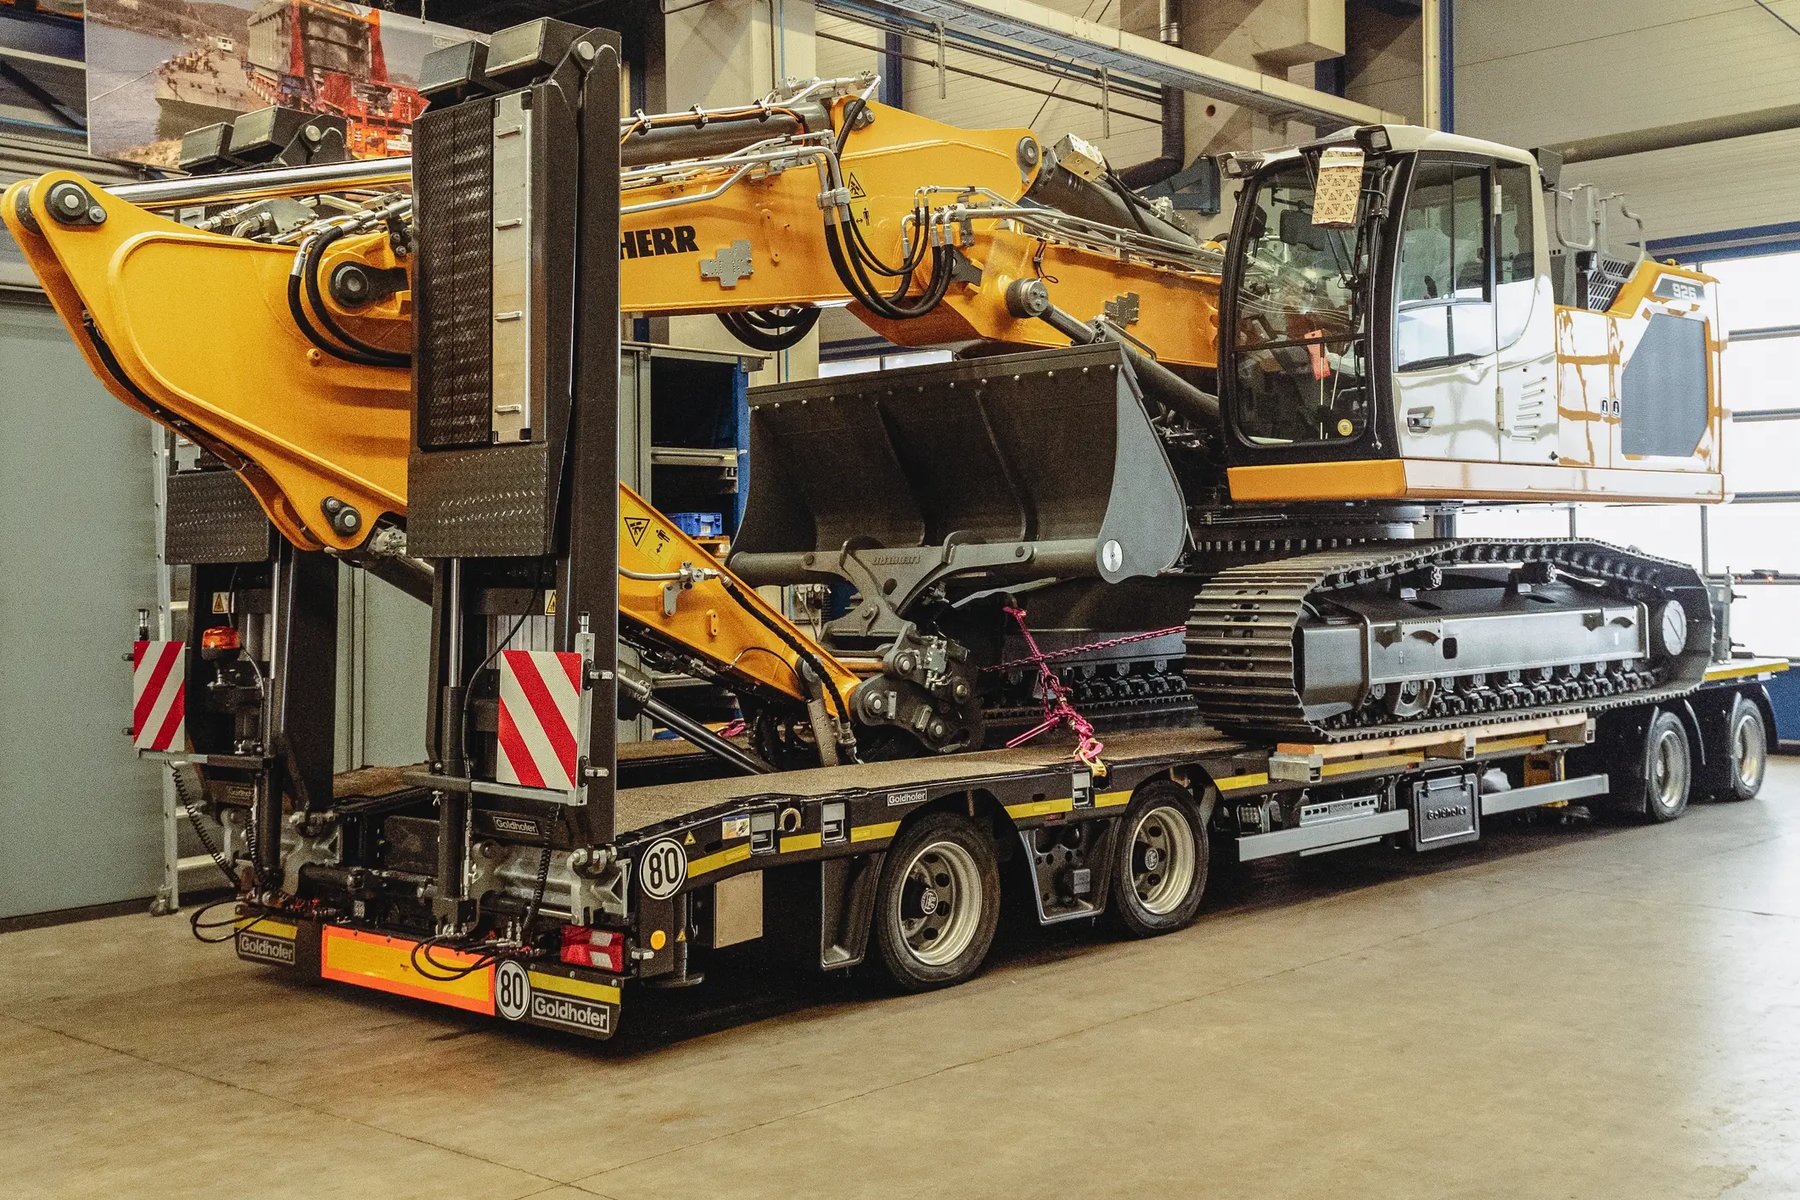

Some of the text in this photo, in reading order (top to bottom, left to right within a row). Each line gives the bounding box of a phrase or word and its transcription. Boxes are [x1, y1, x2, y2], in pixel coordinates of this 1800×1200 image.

[889, 792, 926, 804] Goldhofer
[496, 819, 536, 832] Goldhofer
[648, 847, 680, 890] 80
[241, 936, 293, 960] Goldhofer
[500, 969, 524, 1010] 80
[534, 996, 607, 1027] Goldhofer
